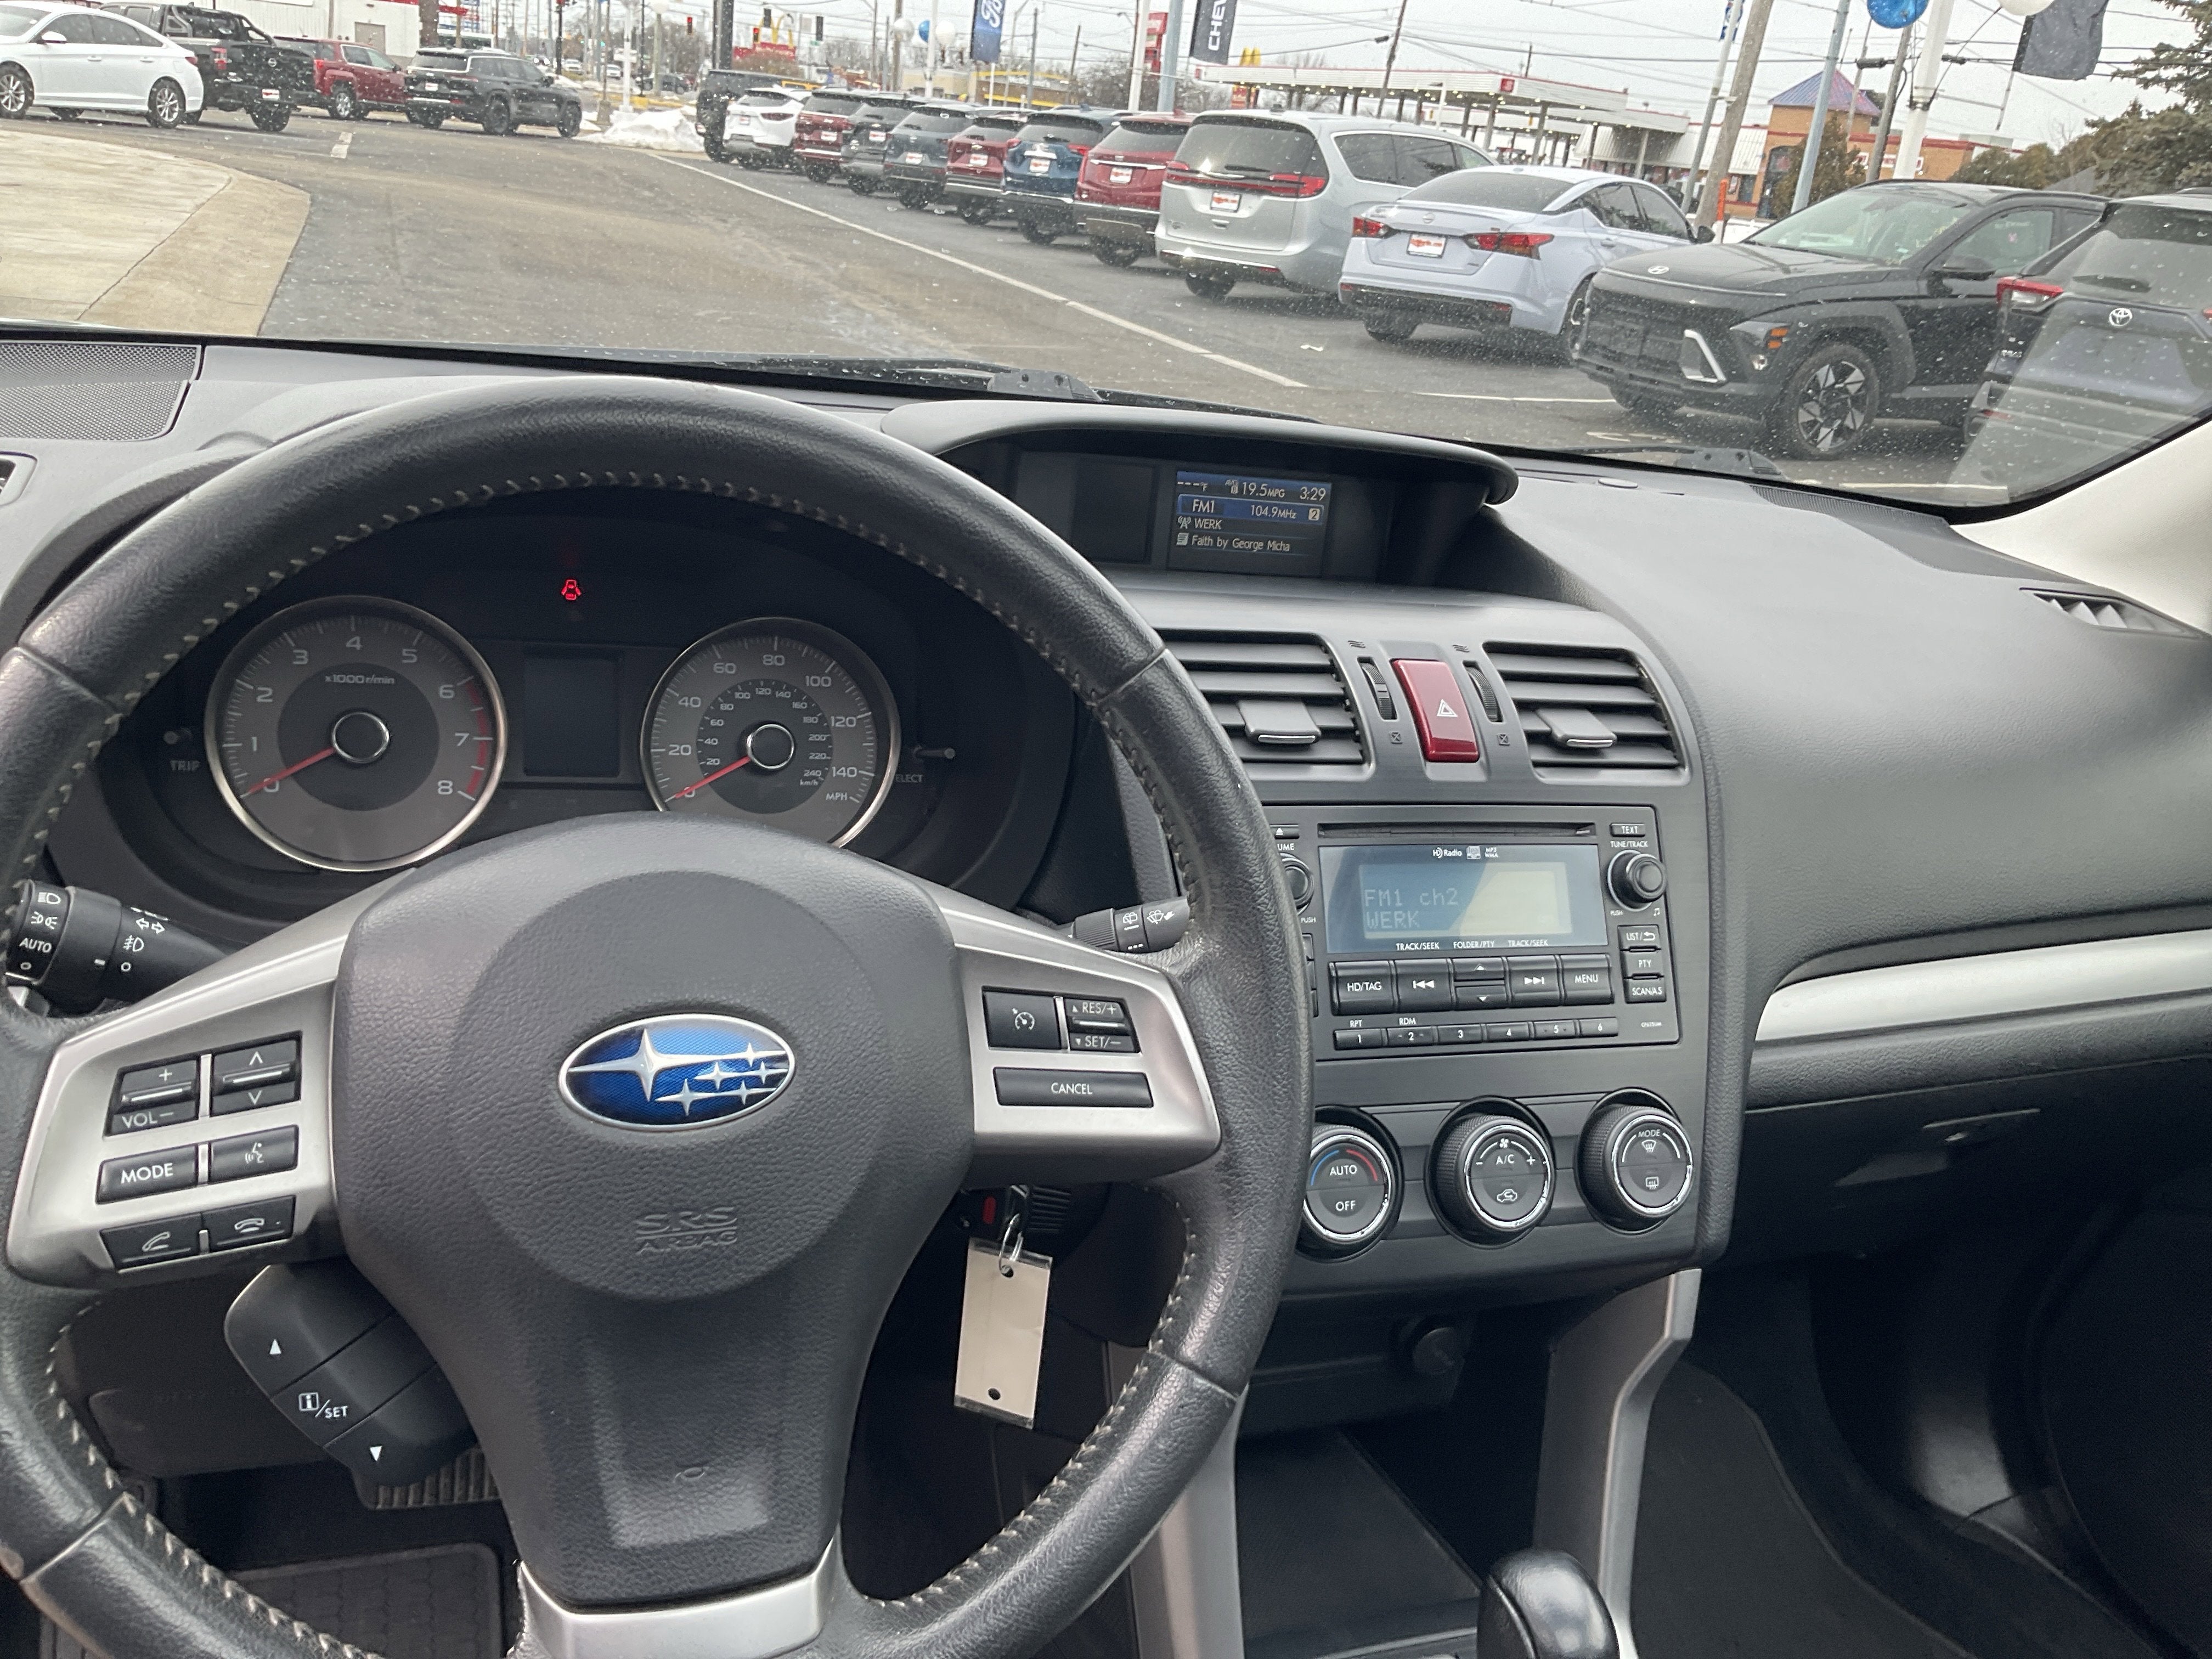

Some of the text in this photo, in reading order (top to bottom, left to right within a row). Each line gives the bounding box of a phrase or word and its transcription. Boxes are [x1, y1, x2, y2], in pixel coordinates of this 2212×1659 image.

[1300, 486, 1326, 501] 3:29
[1192, 499, 1215, 514] FM1
[1194, 518, 1222, 530] WERK
[1192, 535, 1290, 552] Faith by George Micha
[346, 636, 363, 650] 4
[293, 650, 309, 664] 3
[402, 649, 417, 663] 5
[763, 654, 785, 666] 80
[714, 662, 737, 674] 60
[805, 675, 831, 687] 100
[256, 686, 273, 703] 2
[439, 684, 454, 699] 6
[678, 696, 701, 708] 40
[830, 716, 856, 728] 120
[251, 736, 257, 752] 1
[455, 732, 470, 747] 7
[669, 744, 692, 756] 20
[170, 759, 200, 772] TRIP
[832, 766, 857, 778] 140
[894, 774, 923, 783] ELECT
[437, 780, 453, 795] 8
[826, 792, 848, 802] MPH
[1621, 826, 1638, 834] TEXT
[1277, 843, 1295, 851] UME
[1365, 888, 1458, 907] FM1 ch2
[1365, 911, 1420, 929] WERK
[19, 937, 53, 953] AUTO
[1396, 942, 1440, 951] TRACK/SEEK
[1453, 940, 1494, 949] FOLDER/PTY
[1508, 939, 1549, 947] TRACK/SEEK
[1638, 960, 1651, 968] PTY
[1575, 974, 1598, 984] MENU
[1347, 981, 1382, 992] HD/TAG
[1350, 1019, 1363, 1028] RPT
[1399, 1017, 1417, 1025] RDM
[1598, 1023, 1603, 1031] 6
[1458, 1029, 1464, 1039] 3
[1506, 1028, 1511, 1037] 4
[1554, 1025, 1559, 1034] 5
[1357, 1034, 1362, 1043] 1
[1408, 1031, 1414, 1041] 2
[1051, 1082, 1093, 1094] CANCEL
[1638, 1128, 1661, 1138] MODE
[1496, 1153, 1515, 1165] A/C
[120, 1163, 174, 1184] MODE
[1329, 1164, 1358, 1177] AUTO
[1335, 1199, 1356, 1212] OFF
[634, 1207, 737, 1233] SRS
